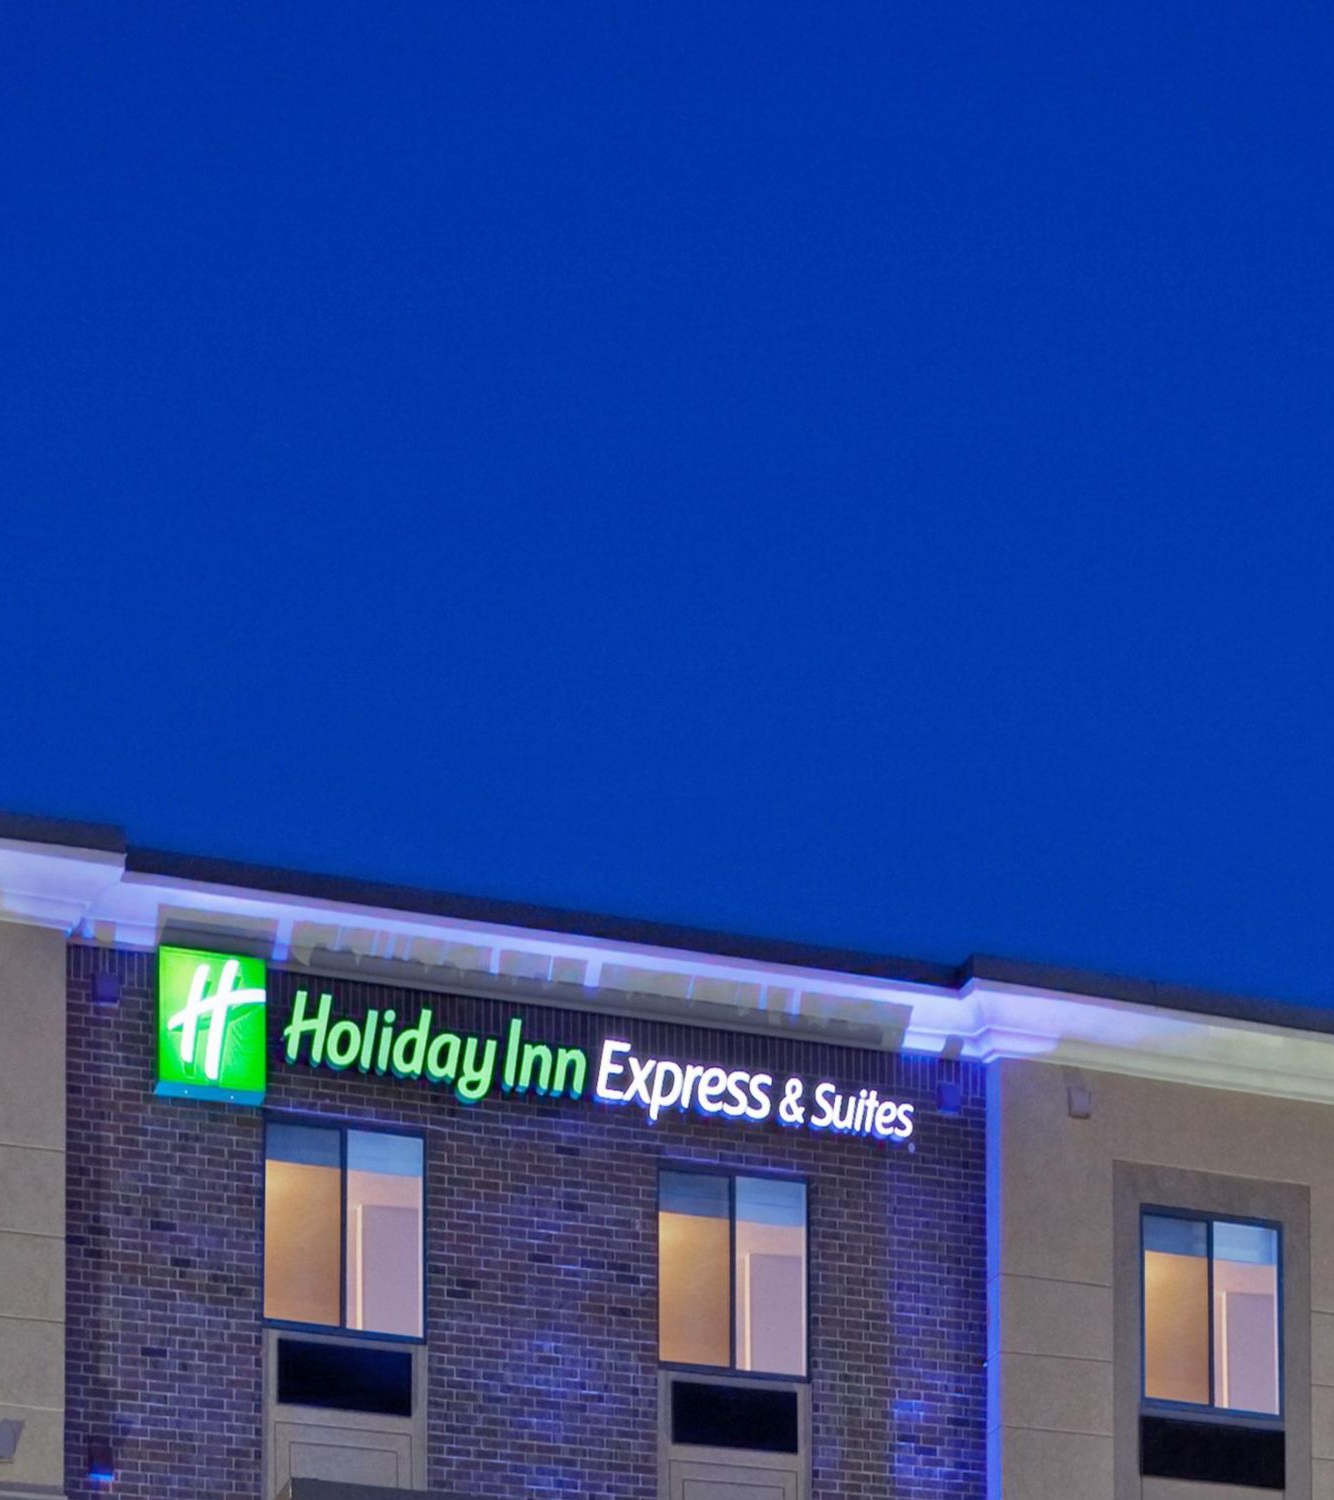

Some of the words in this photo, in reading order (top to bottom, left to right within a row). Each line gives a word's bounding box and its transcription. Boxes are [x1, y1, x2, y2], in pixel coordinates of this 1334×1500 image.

[283, 990, 497, 1099] Holiday
[504, 1018, 587, 1096] Inn
[596, 1039, 772, 1121] Express
[778, 1077, 805, 1124] &
[810, 1082, 915, 1139] Suites
